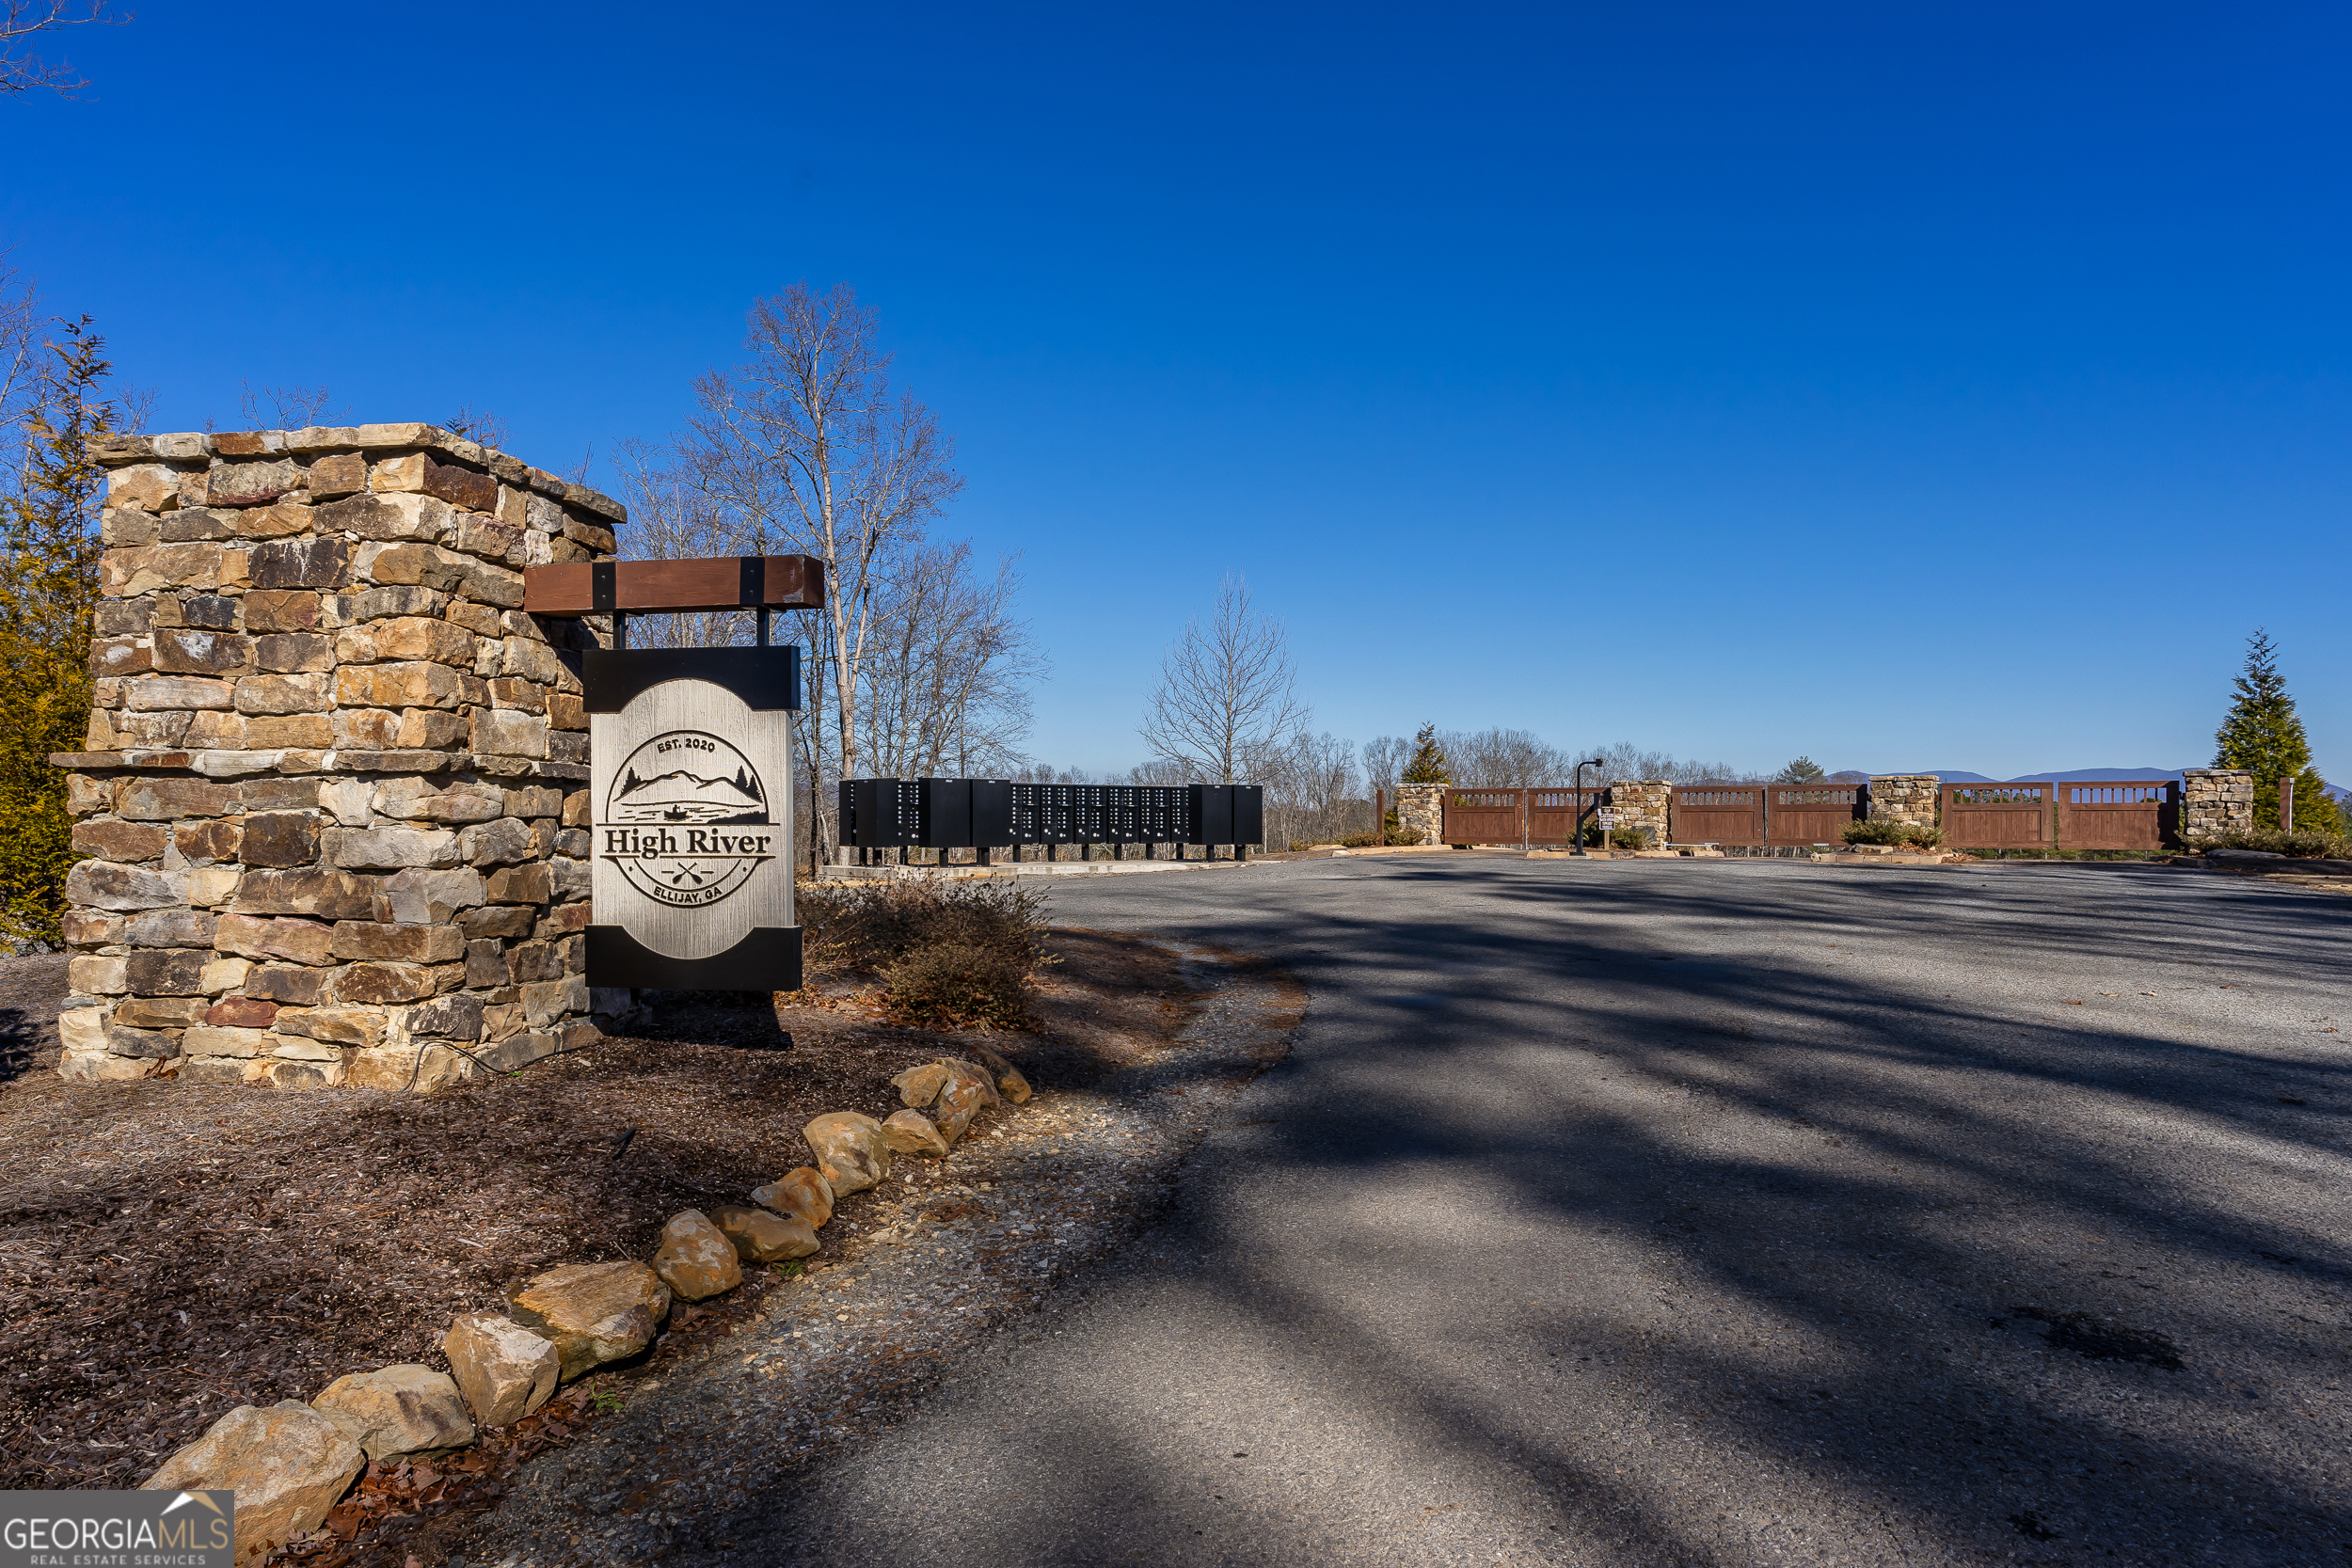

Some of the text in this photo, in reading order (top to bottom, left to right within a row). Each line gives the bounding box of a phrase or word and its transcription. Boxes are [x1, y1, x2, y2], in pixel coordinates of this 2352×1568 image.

[657, 738, 716, 753] EST. 2020
[604, 828, 771, 860] High River
[653, 886, 723, 904] ELLIJAY, GA
